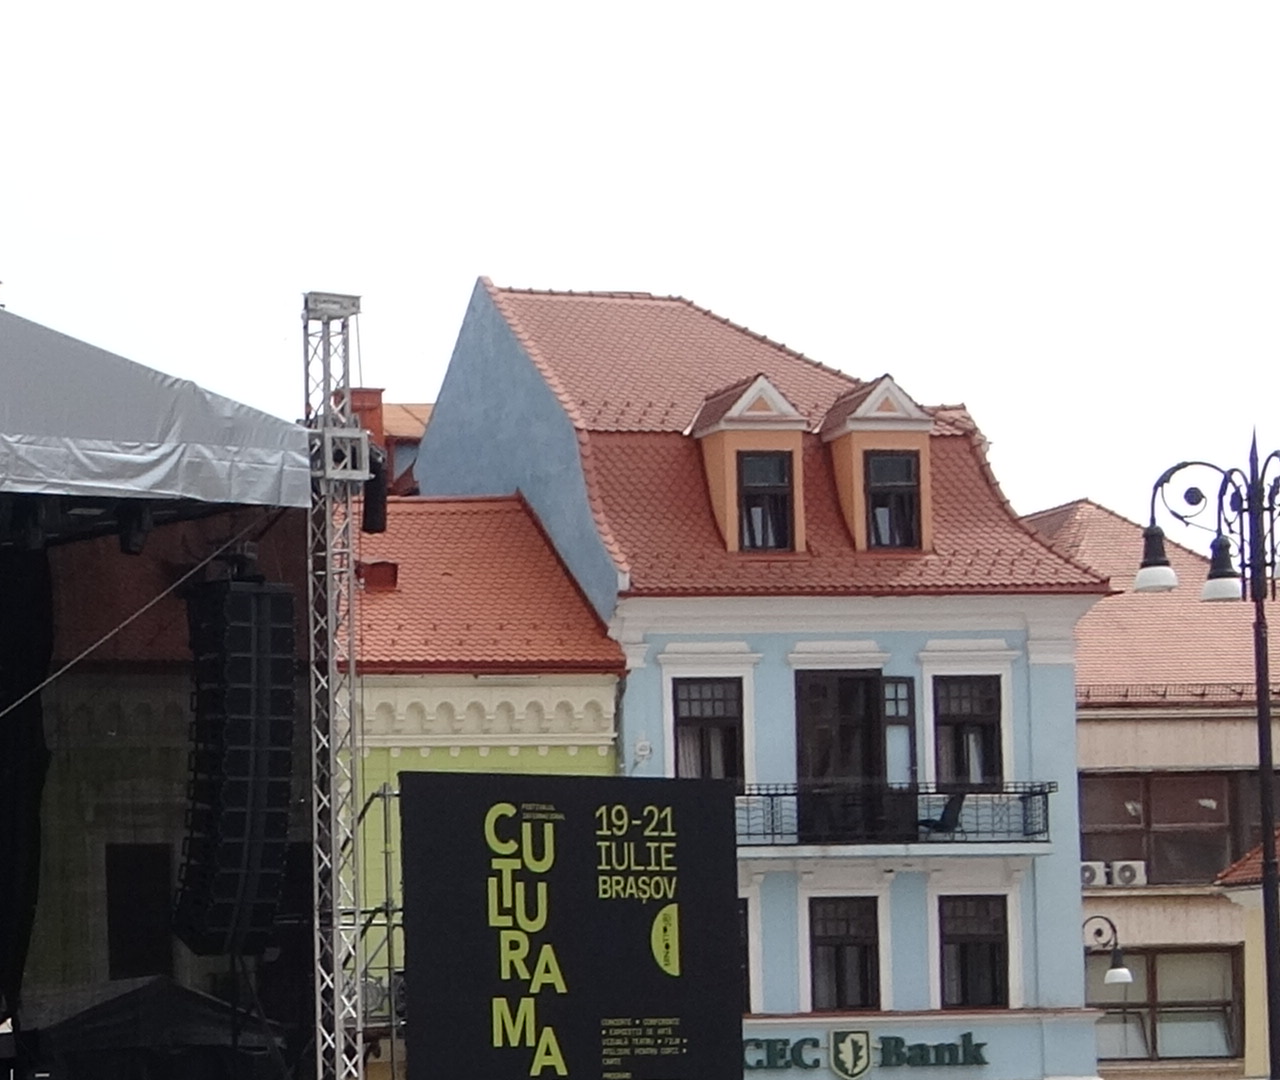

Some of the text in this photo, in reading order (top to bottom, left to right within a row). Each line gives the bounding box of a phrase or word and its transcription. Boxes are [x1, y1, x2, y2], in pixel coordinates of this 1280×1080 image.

[595, 804, 677, 836] 19-21
[596, 841, 678, 871] IULIE
[598, 875, 677, 904] BRAȘOV
[743, 1032, 989, 1070] CEC Bank
